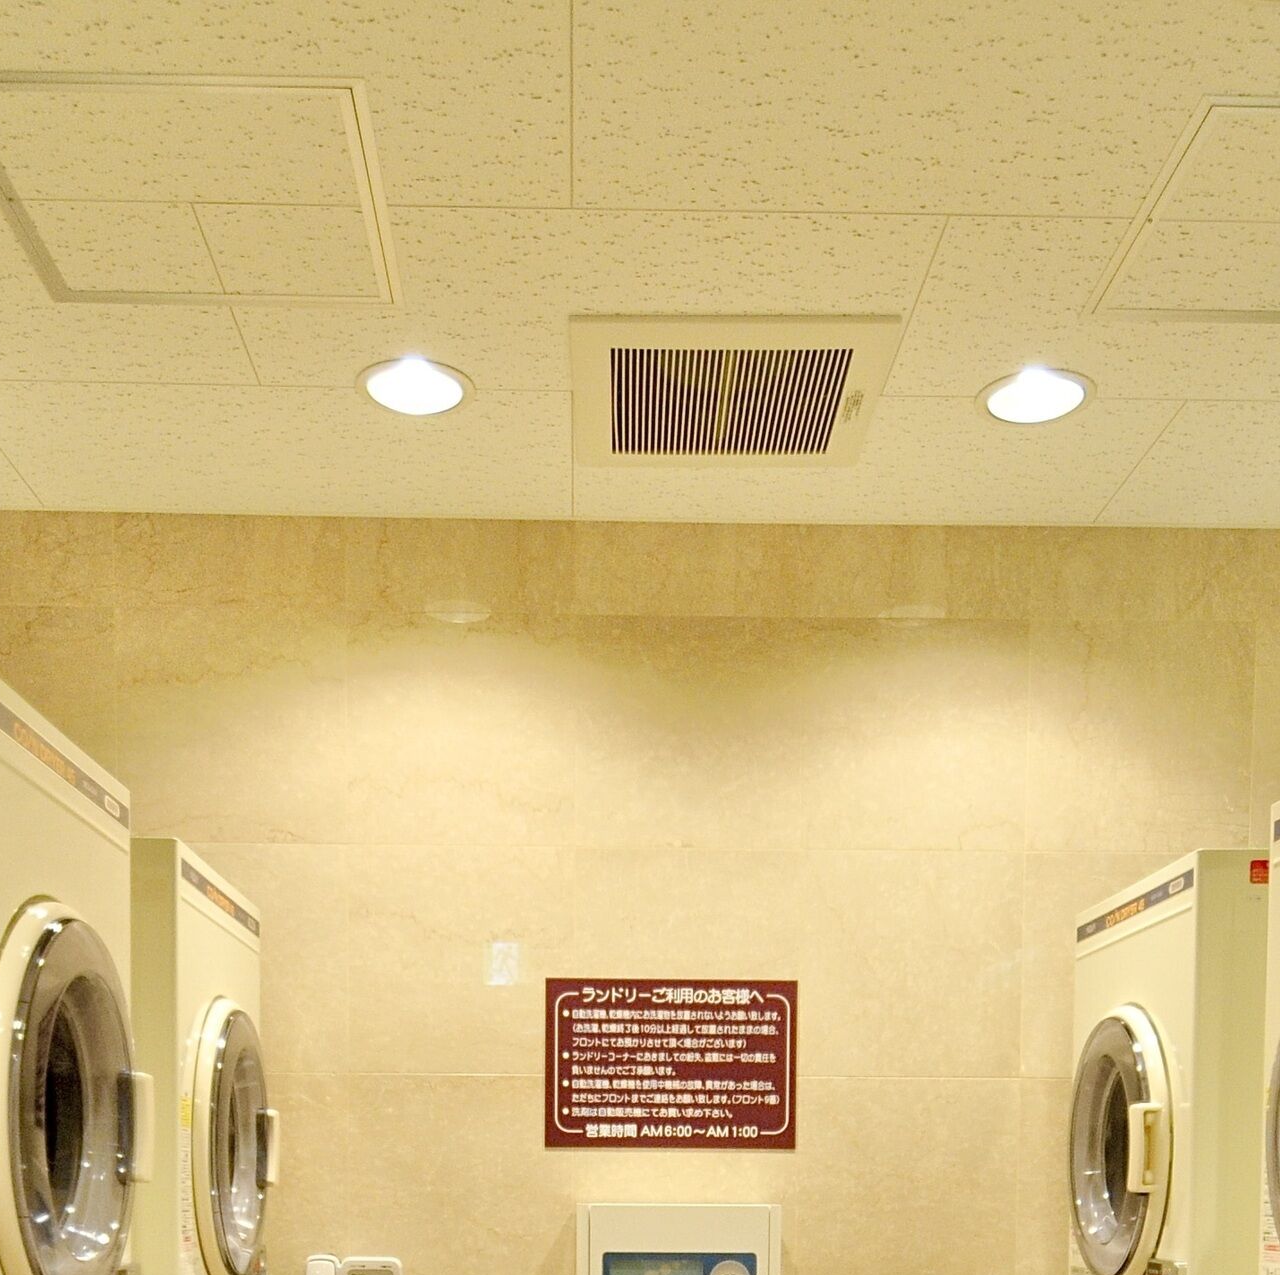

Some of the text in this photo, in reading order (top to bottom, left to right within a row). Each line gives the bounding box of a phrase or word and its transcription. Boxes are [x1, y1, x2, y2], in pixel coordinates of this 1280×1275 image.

[582, 986, 765, 1005] ランドリーご利用のお客様へ
[585, 1123, 638, 1138] 営業時間
